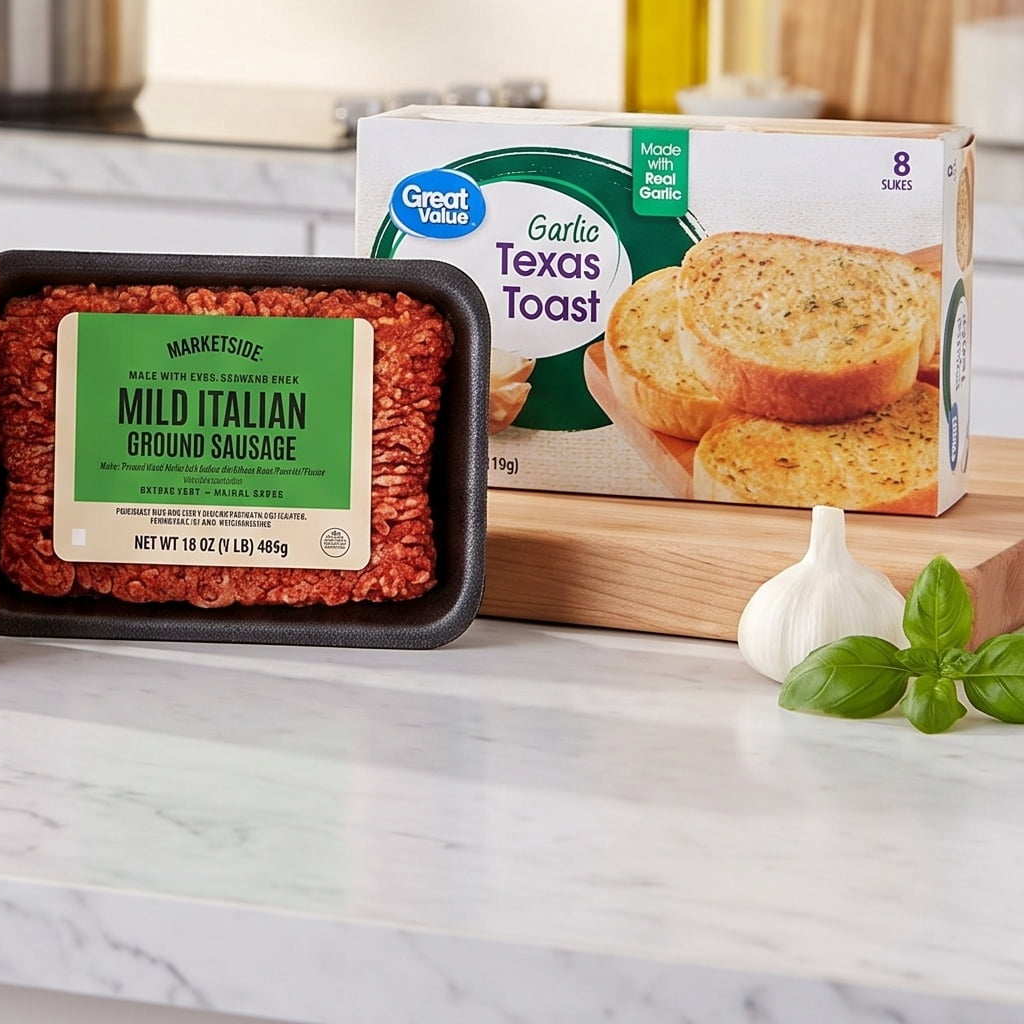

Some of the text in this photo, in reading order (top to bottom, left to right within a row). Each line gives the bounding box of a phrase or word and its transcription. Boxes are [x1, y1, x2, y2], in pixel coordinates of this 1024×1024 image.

[640, 142, 682, 156] Made
[647, 157, 674, 171] with
[893, 151, 911, 177] 8
[645, 171, 676, 186] Real
[402, 184, 469, 210] Great
[639, 186, 682, 200] Garlic
[418, 207, 469, 225] Value
[528, 214, 600, 243] Garlic
[495, 242, 601, 280] Texas
[502, 286, 601, 323] Toast
[166, 335, 264, 362] MARKETSIDE
[160, 372, 187, 382] WITH
[118, 387, 307, 430] MILD ITALIAN
[127, 431, 297, 461] GROUND SAUSAGE
[134, 535, 157, 550] NET
[160, 536, 179, 551] WT
[200, 537, 215, 552] OZ
[233, 538, 254, 556] LB)
